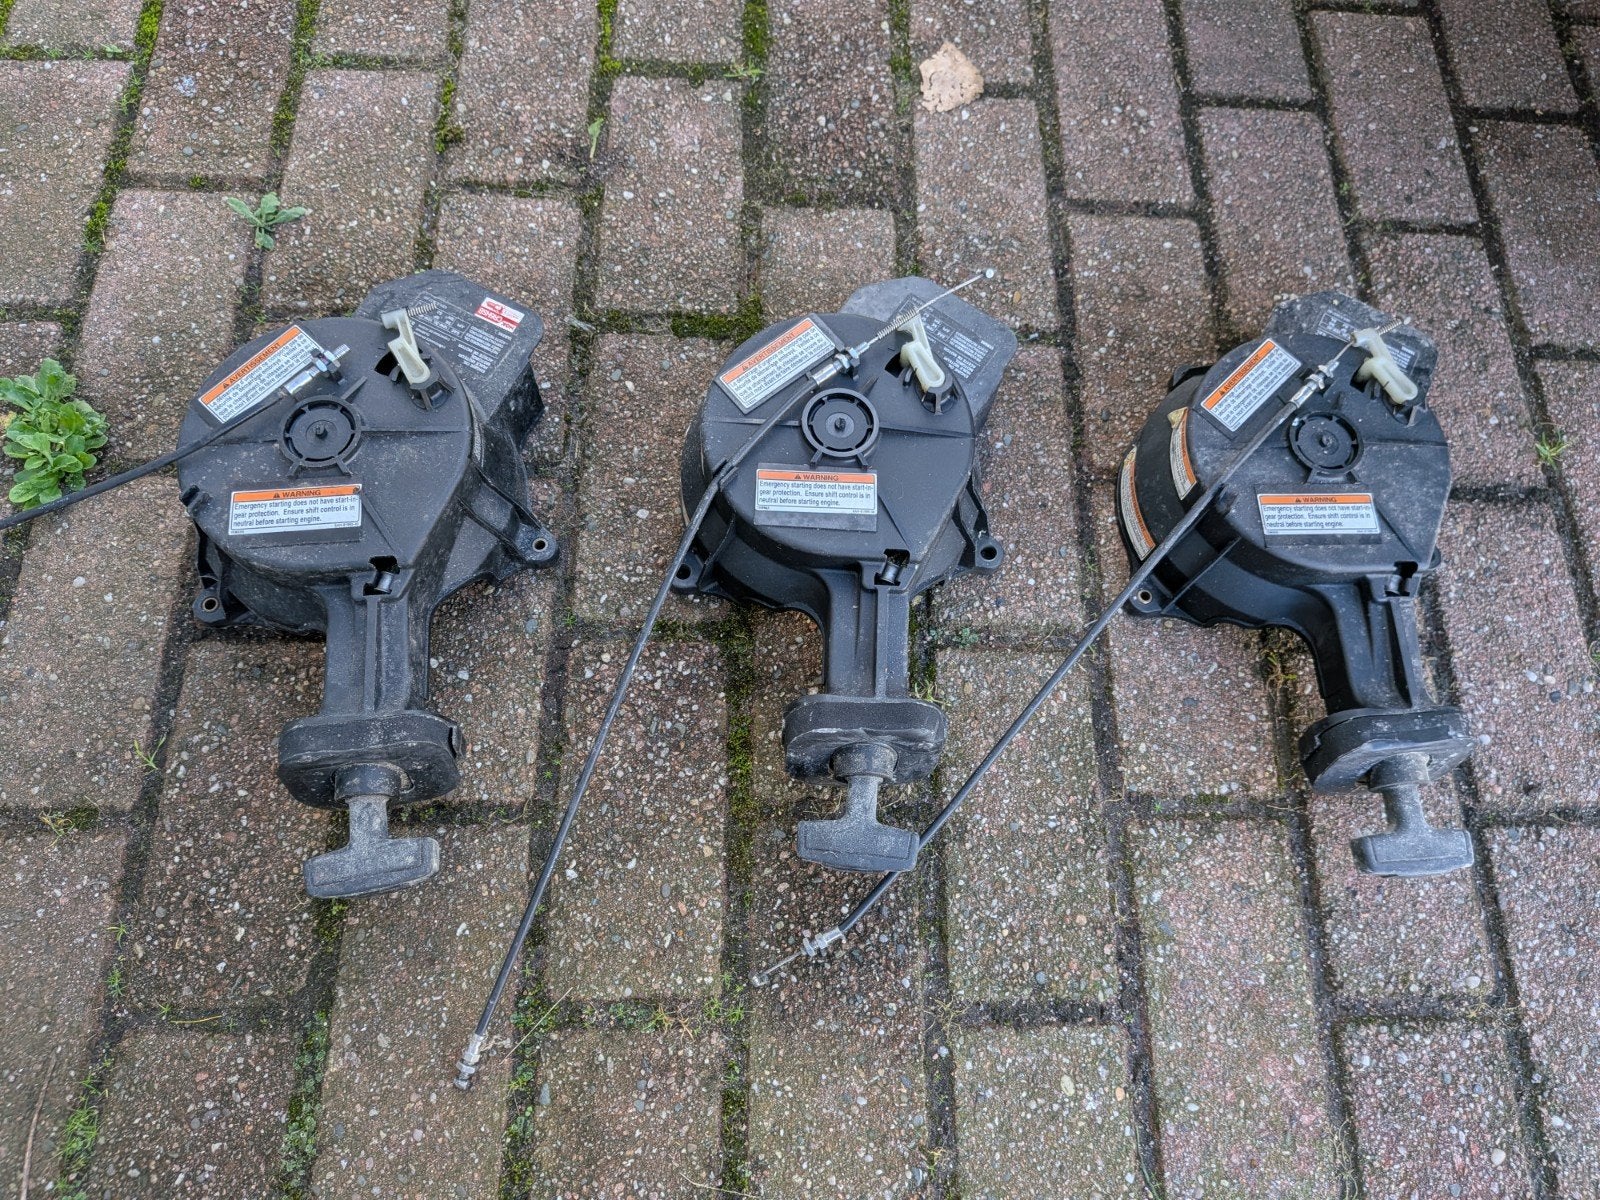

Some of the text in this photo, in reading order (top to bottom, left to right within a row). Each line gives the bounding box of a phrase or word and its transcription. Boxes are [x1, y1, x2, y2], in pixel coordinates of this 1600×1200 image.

[747, 331, 796, 366] AVERTISSEMENT
[227, 342, 281, 383] AVERTISSEMENT
[234, 502, 267, 510] Emergency
[269, 500, 291, 508] starting
[249, 510, 280, 518] protection.
[276, 516, 298, 525] starting
[300, 515, 321, 523] engine.
